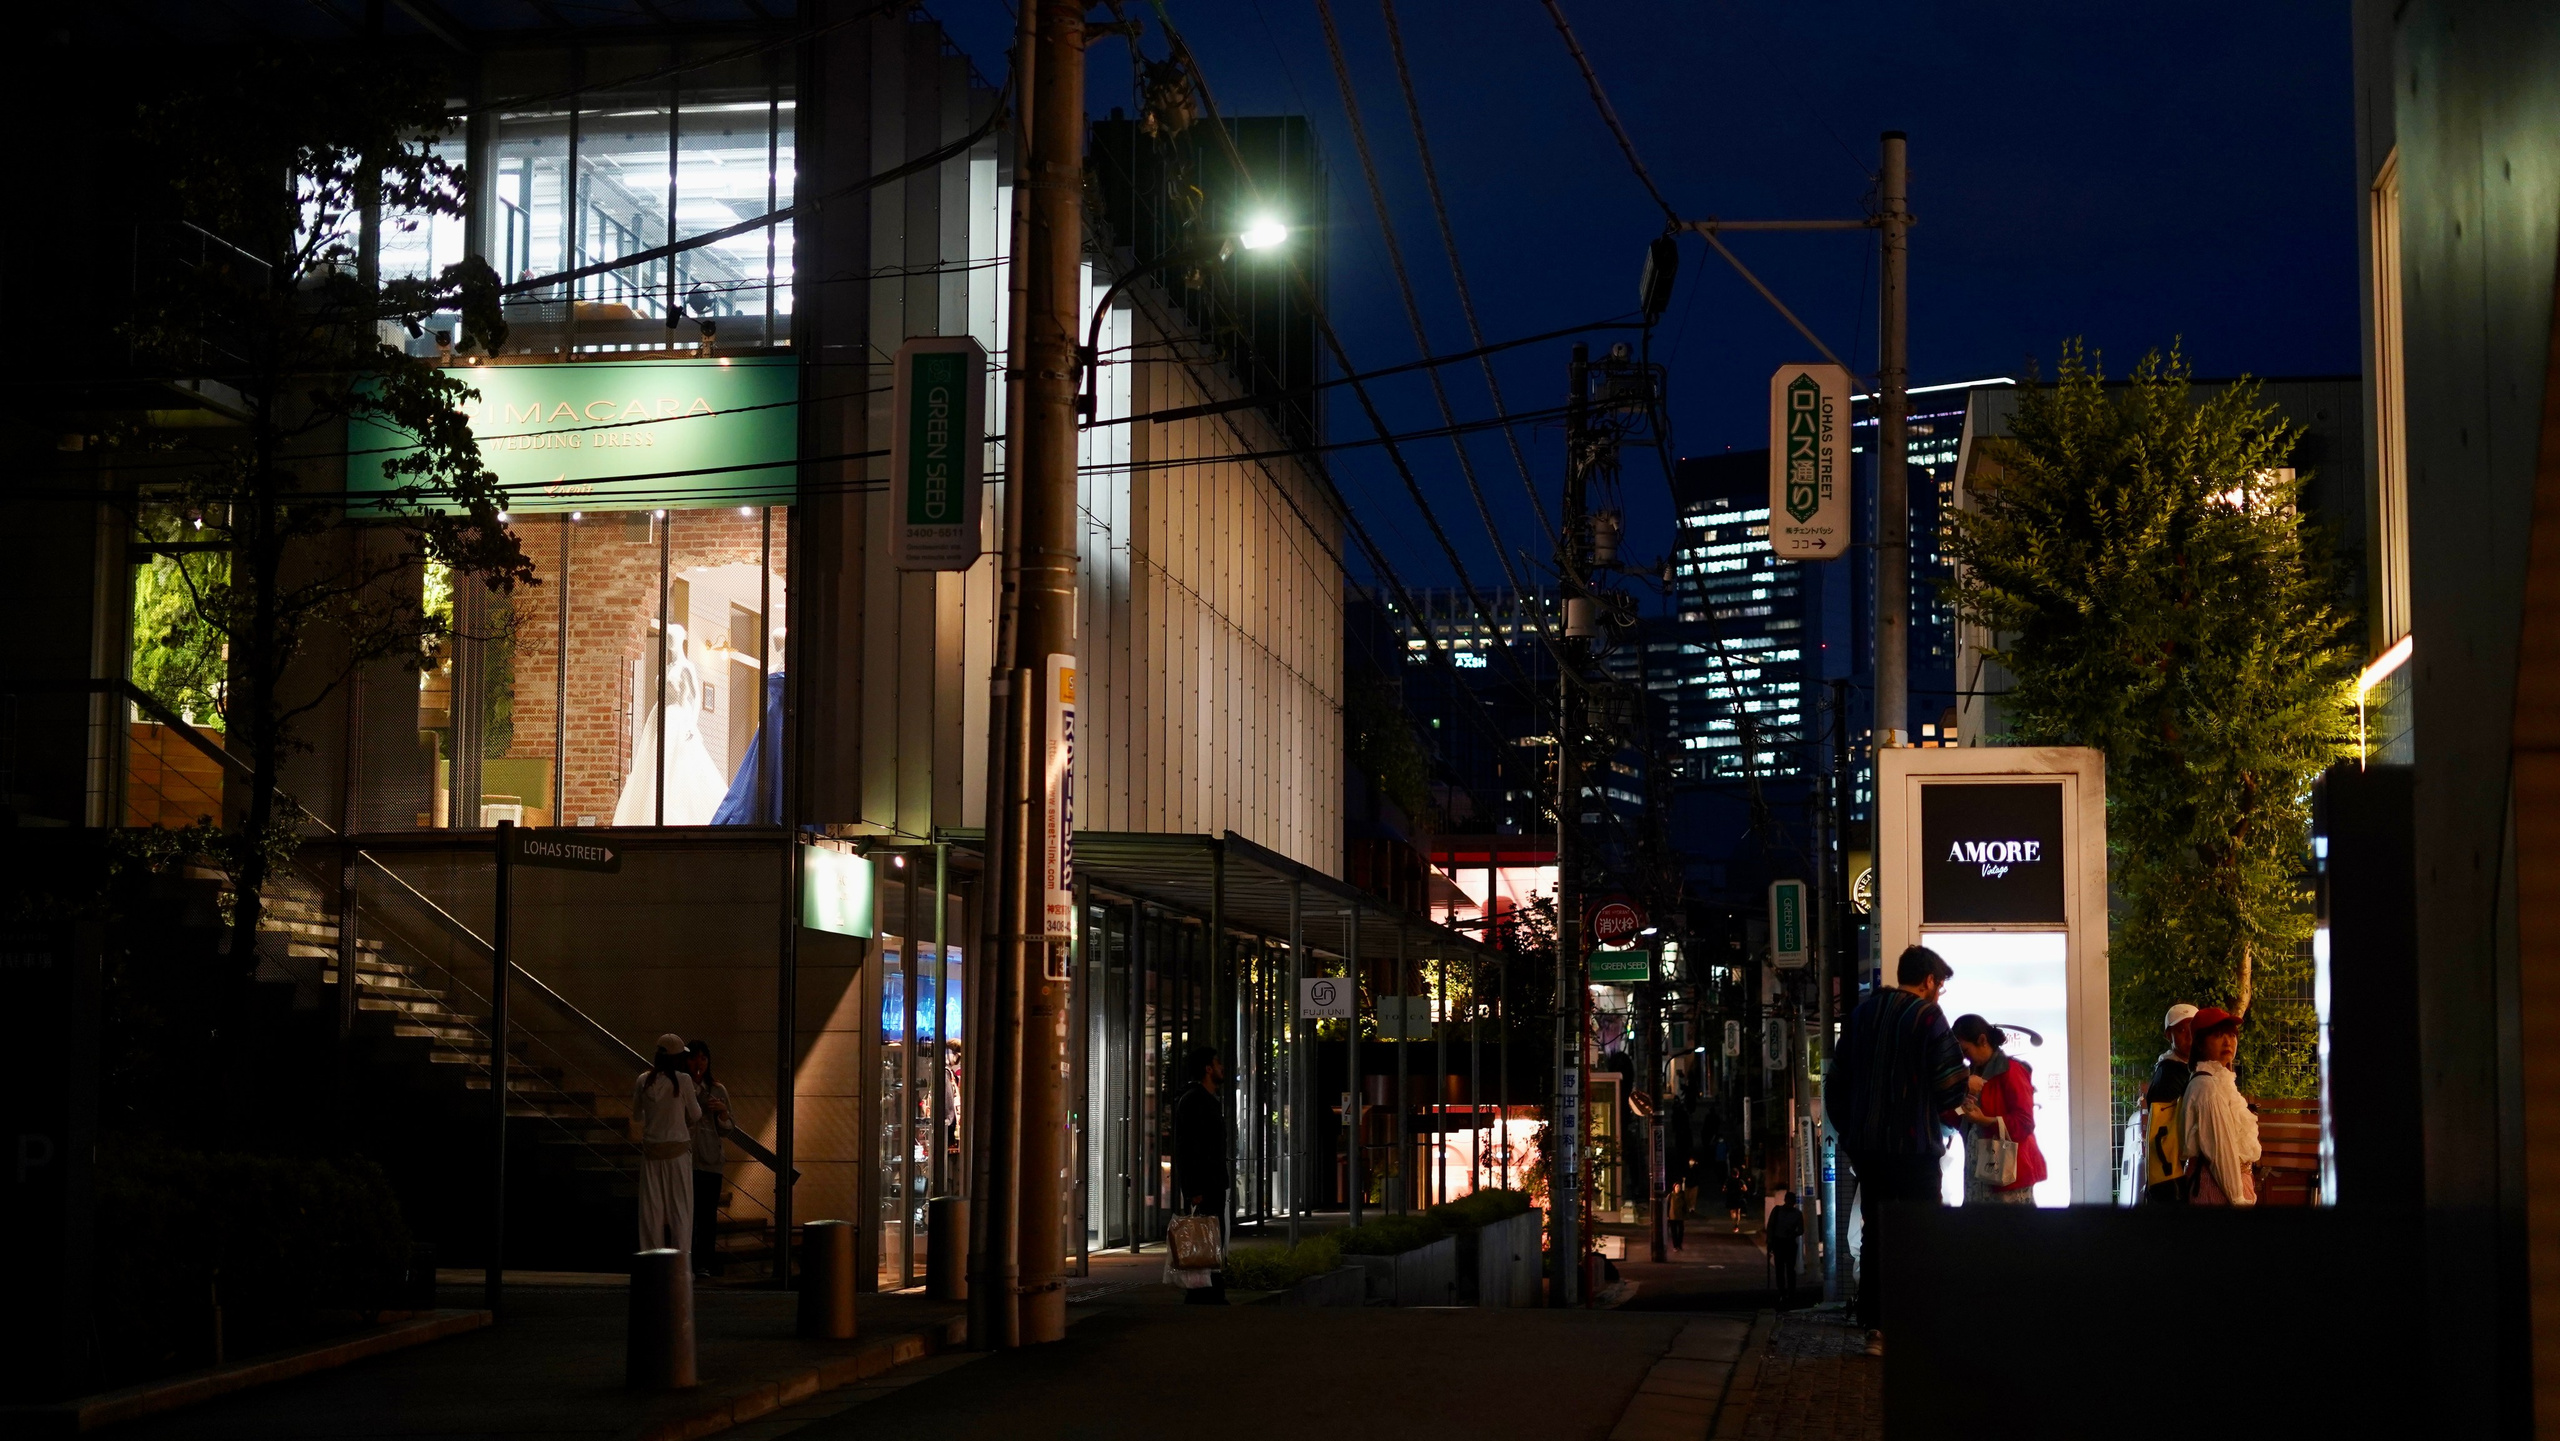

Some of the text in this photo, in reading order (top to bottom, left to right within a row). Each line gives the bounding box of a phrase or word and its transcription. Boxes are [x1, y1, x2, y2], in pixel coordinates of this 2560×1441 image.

[455, 397, 717, 425] RIMACARA
[489, 430, 656, 451] WEDDING DRESS
[1790, 389, 1816, 511] ロハス通り
[1821, 396, 1833, 501] LOHAS STREET
[925, 386, 949, 519] GREEN SEED
[1792, 539, 1809, 549] ココ
[523, 840, 604, 861] LOHAS STREET
[1946, 840, 2041, 863] AMORE
[1981, 863, 2009, 879] Vintage
[1783, 897, 1793, 927] GREEN
[1599, 916, 1635, 934] 消火栓
[1784, 927, 1794, 950] SEED
[1600, 961, 1648, 971] GREEN SEED
[1327, 1008, 1345, 1016] UNI
[1562, 1074, 1575, 1148] 野田歯科
